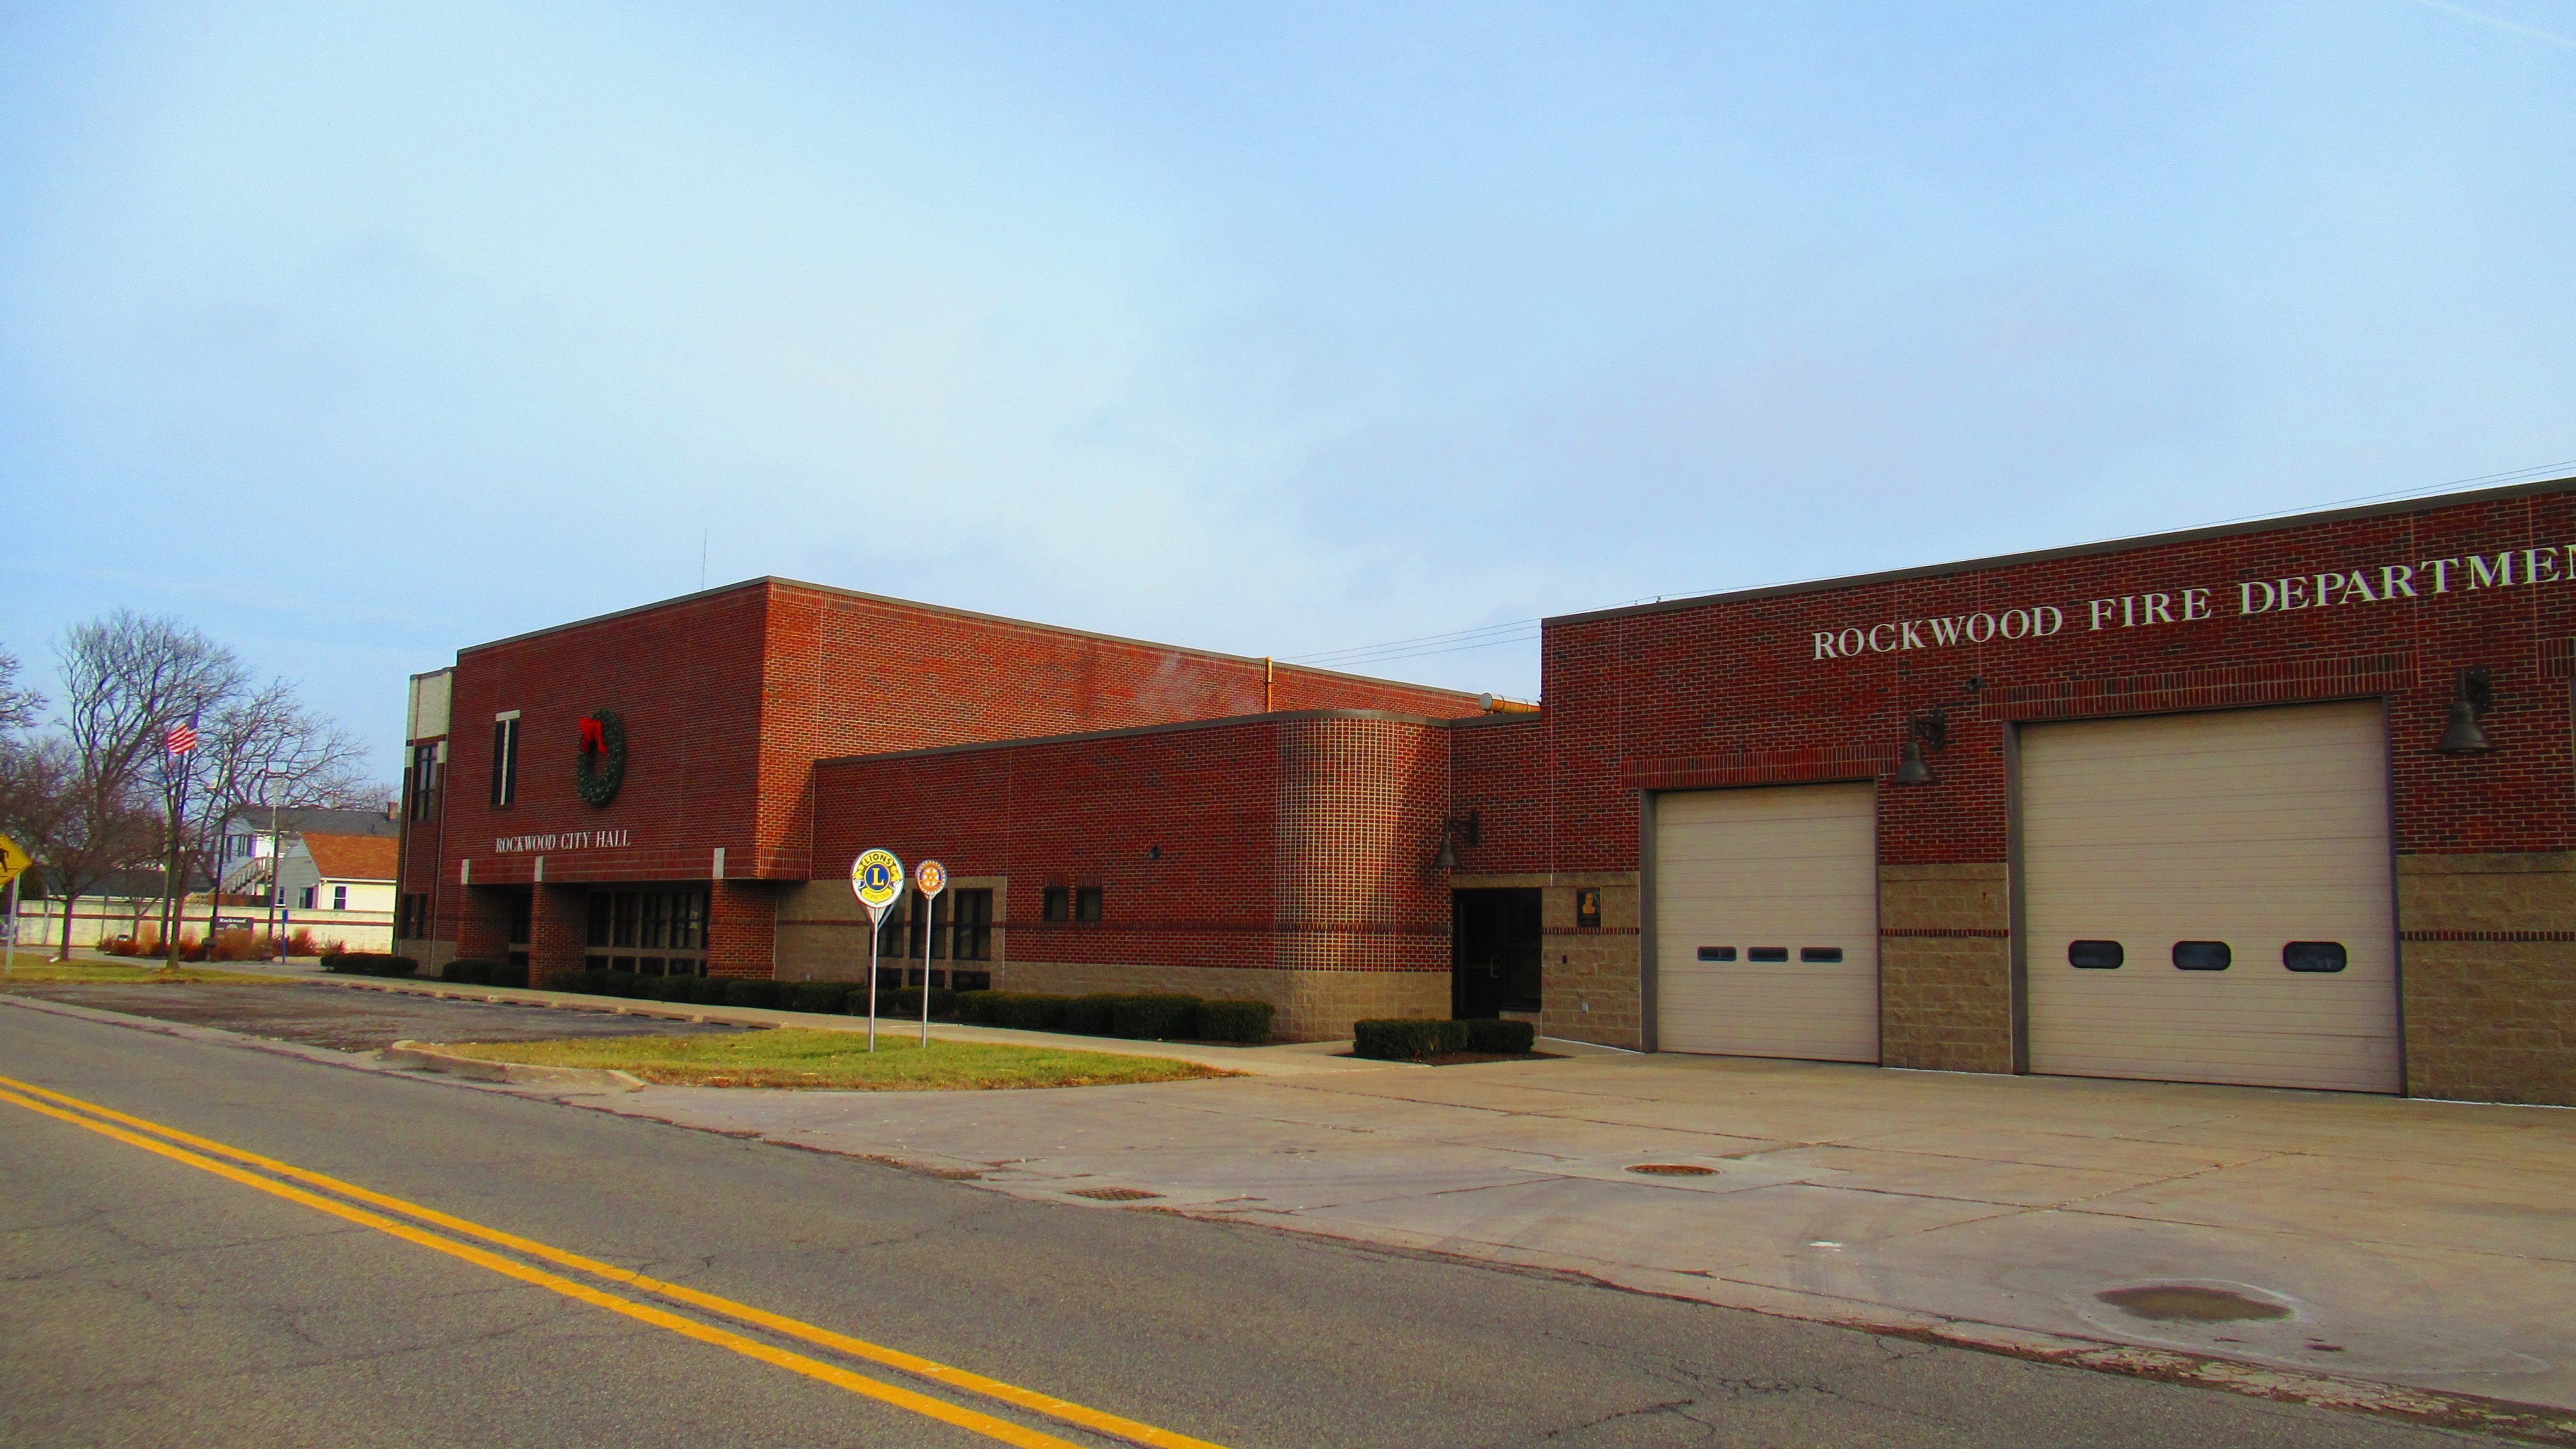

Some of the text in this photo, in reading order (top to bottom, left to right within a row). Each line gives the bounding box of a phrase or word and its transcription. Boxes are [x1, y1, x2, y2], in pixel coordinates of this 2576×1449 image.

[1812, 606, 2063, 660] ROCKWOOD
[2088, 587, 2213, 631] FIRE
[496, 830, 631, 853] ROCKWOOD CITY HALL
[864, 853, 892, 865] LIONS
[872, 868, 885, 886] L
